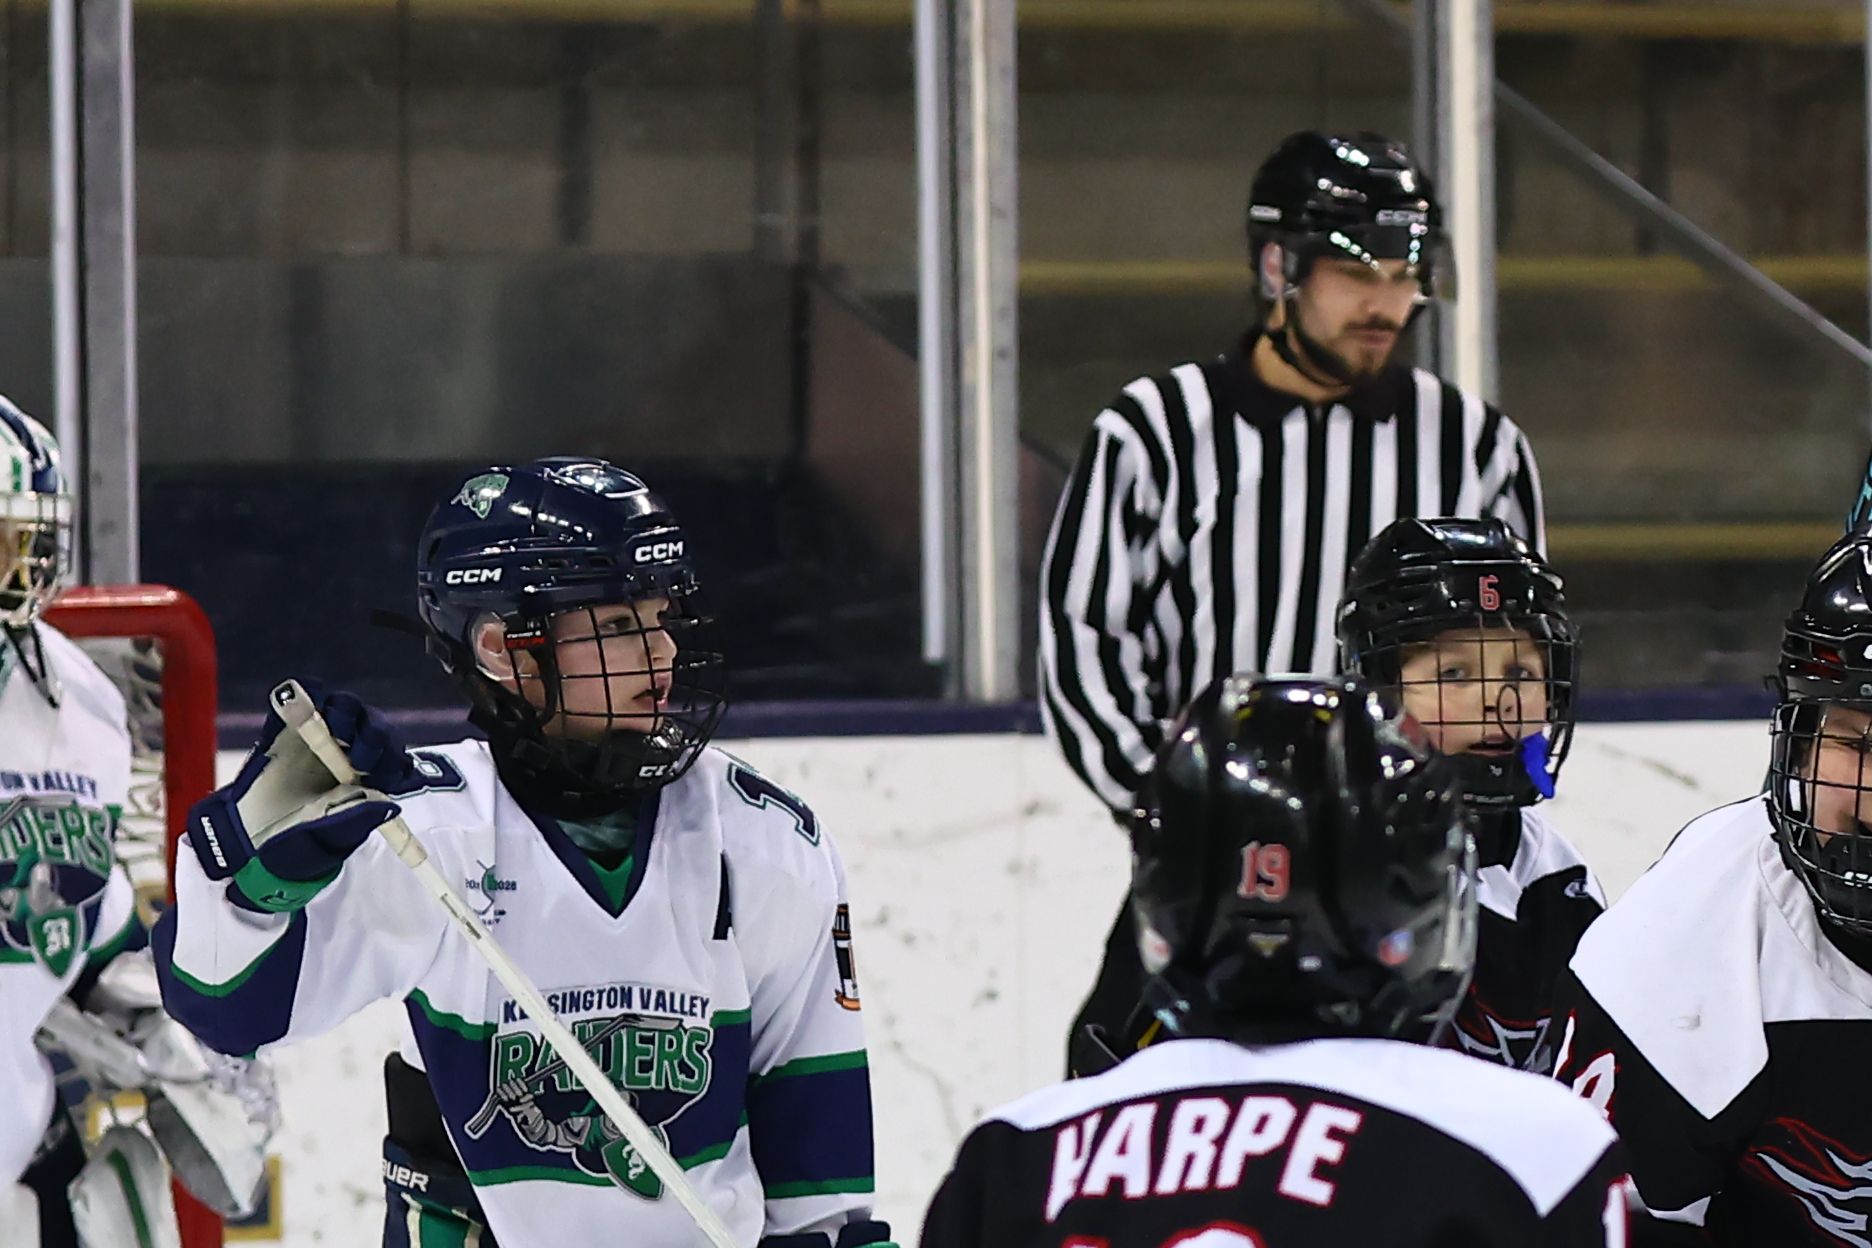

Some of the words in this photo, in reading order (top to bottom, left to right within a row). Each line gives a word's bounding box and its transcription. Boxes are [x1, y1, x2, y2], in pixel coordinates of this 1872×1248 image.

[634, 541, 684, 563] CCM
[446, 567, 502, 585] CCM
[1479, 574, 1500, 610] 6
[1239, 842, 1291, 900] 19
[503, 986, 632, 1024] KSINGTON
[639, 987, 710, 1019] VALLEY
